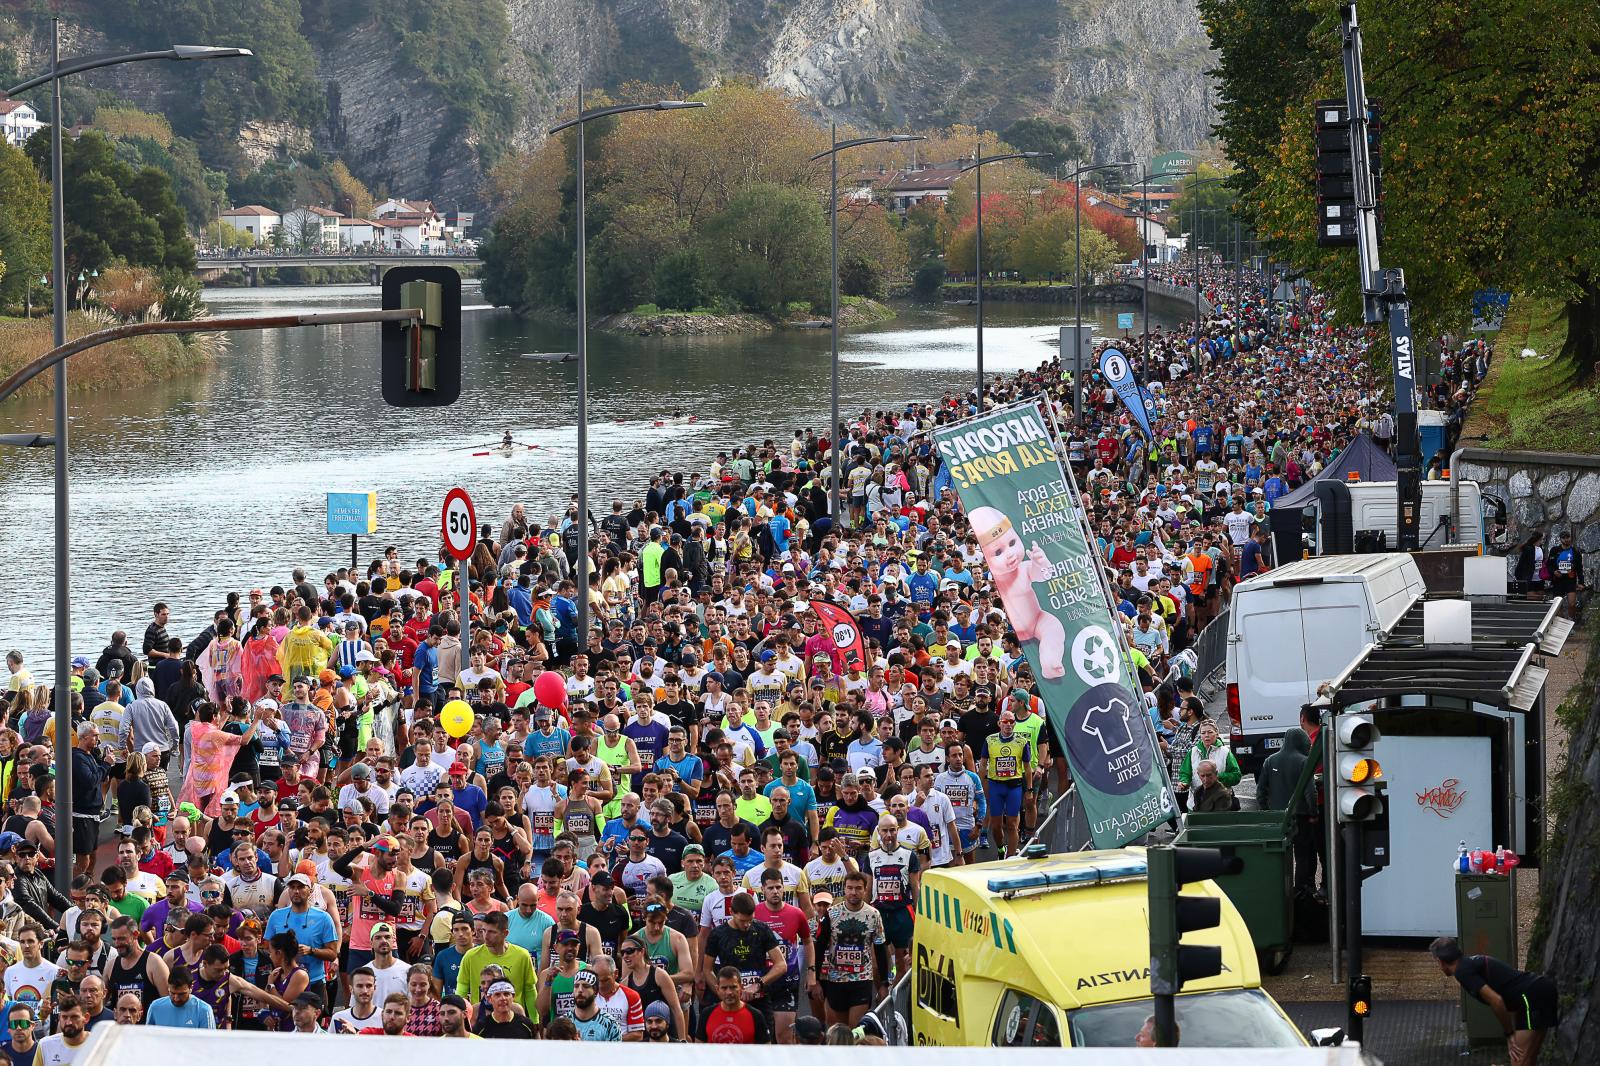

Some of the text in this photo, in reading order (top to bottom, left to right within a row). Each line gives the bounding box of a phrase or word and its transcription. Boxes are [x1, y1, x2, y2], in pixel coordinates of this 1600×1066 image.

[1396, 335, 1413, 380] ATLAS
[450, 511, 469, 536] 50
[947, 790, 966, 798] 4666
[697, 809, 715, 817] 5251
[569, 819, 589, 827] 5004
[878, 881, 900, 890] 4773
[970, 911, 983, 934] 112
[837, 951, 861, 961] 5168
